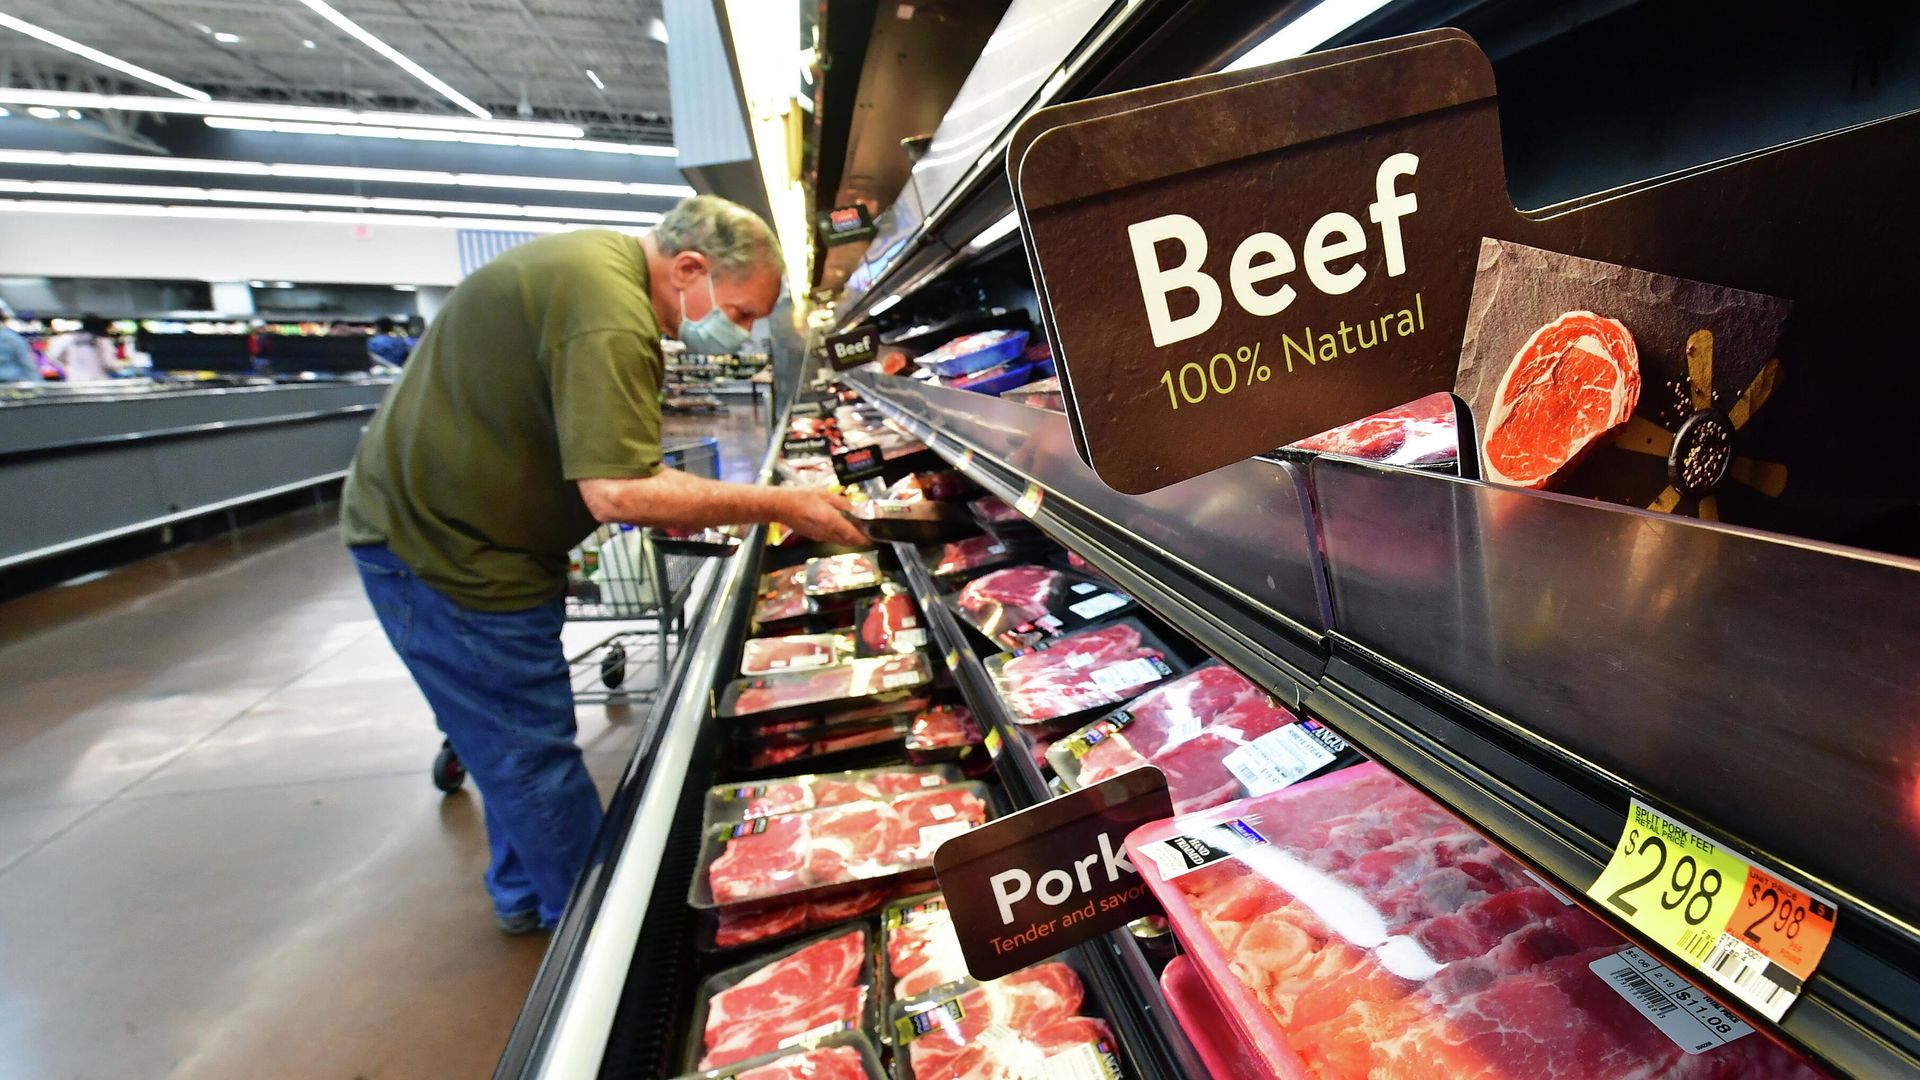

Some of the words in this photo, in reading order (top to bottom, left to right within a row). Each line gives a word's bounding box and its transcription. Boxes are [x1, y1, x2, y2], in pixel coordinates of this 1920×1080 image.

[1127, 153, 1420, 349] Beef
[834, 335, 871, 358] Beef
[1160, 341, 1272, 410] 100%
[1283, 294, 1425, 372] Natural
[1312, 727, 1349, 752] ANGUS
[1635, 806, 1660, 826] SPLIT
[1662, 820, 1688, 840] PORK
[1690, 834, 1715, 855] FEET
[1635, 817, 1661, 836] RETAIL
[1661, 830, 1685, 848] PRICE
[1174, 837, 1205, 865] TRIMMED
[1188, 837, 1210, 857] HAND
[989, 832, 1137, 925] Pork
[1749, 871, 1768, 886] UNIT
[1771, 880, 1797, 901] PRICE
[990, 918, 1057, 955] Tender
[1062, 901, 1096, 927] and
[1100, 883, 1150, 912] savor
[1625, 949, 1650, 968] $5.06
[1653, 972, 1675, 988] 2.19
[1676, 990, 1732, 1034] $11.08
